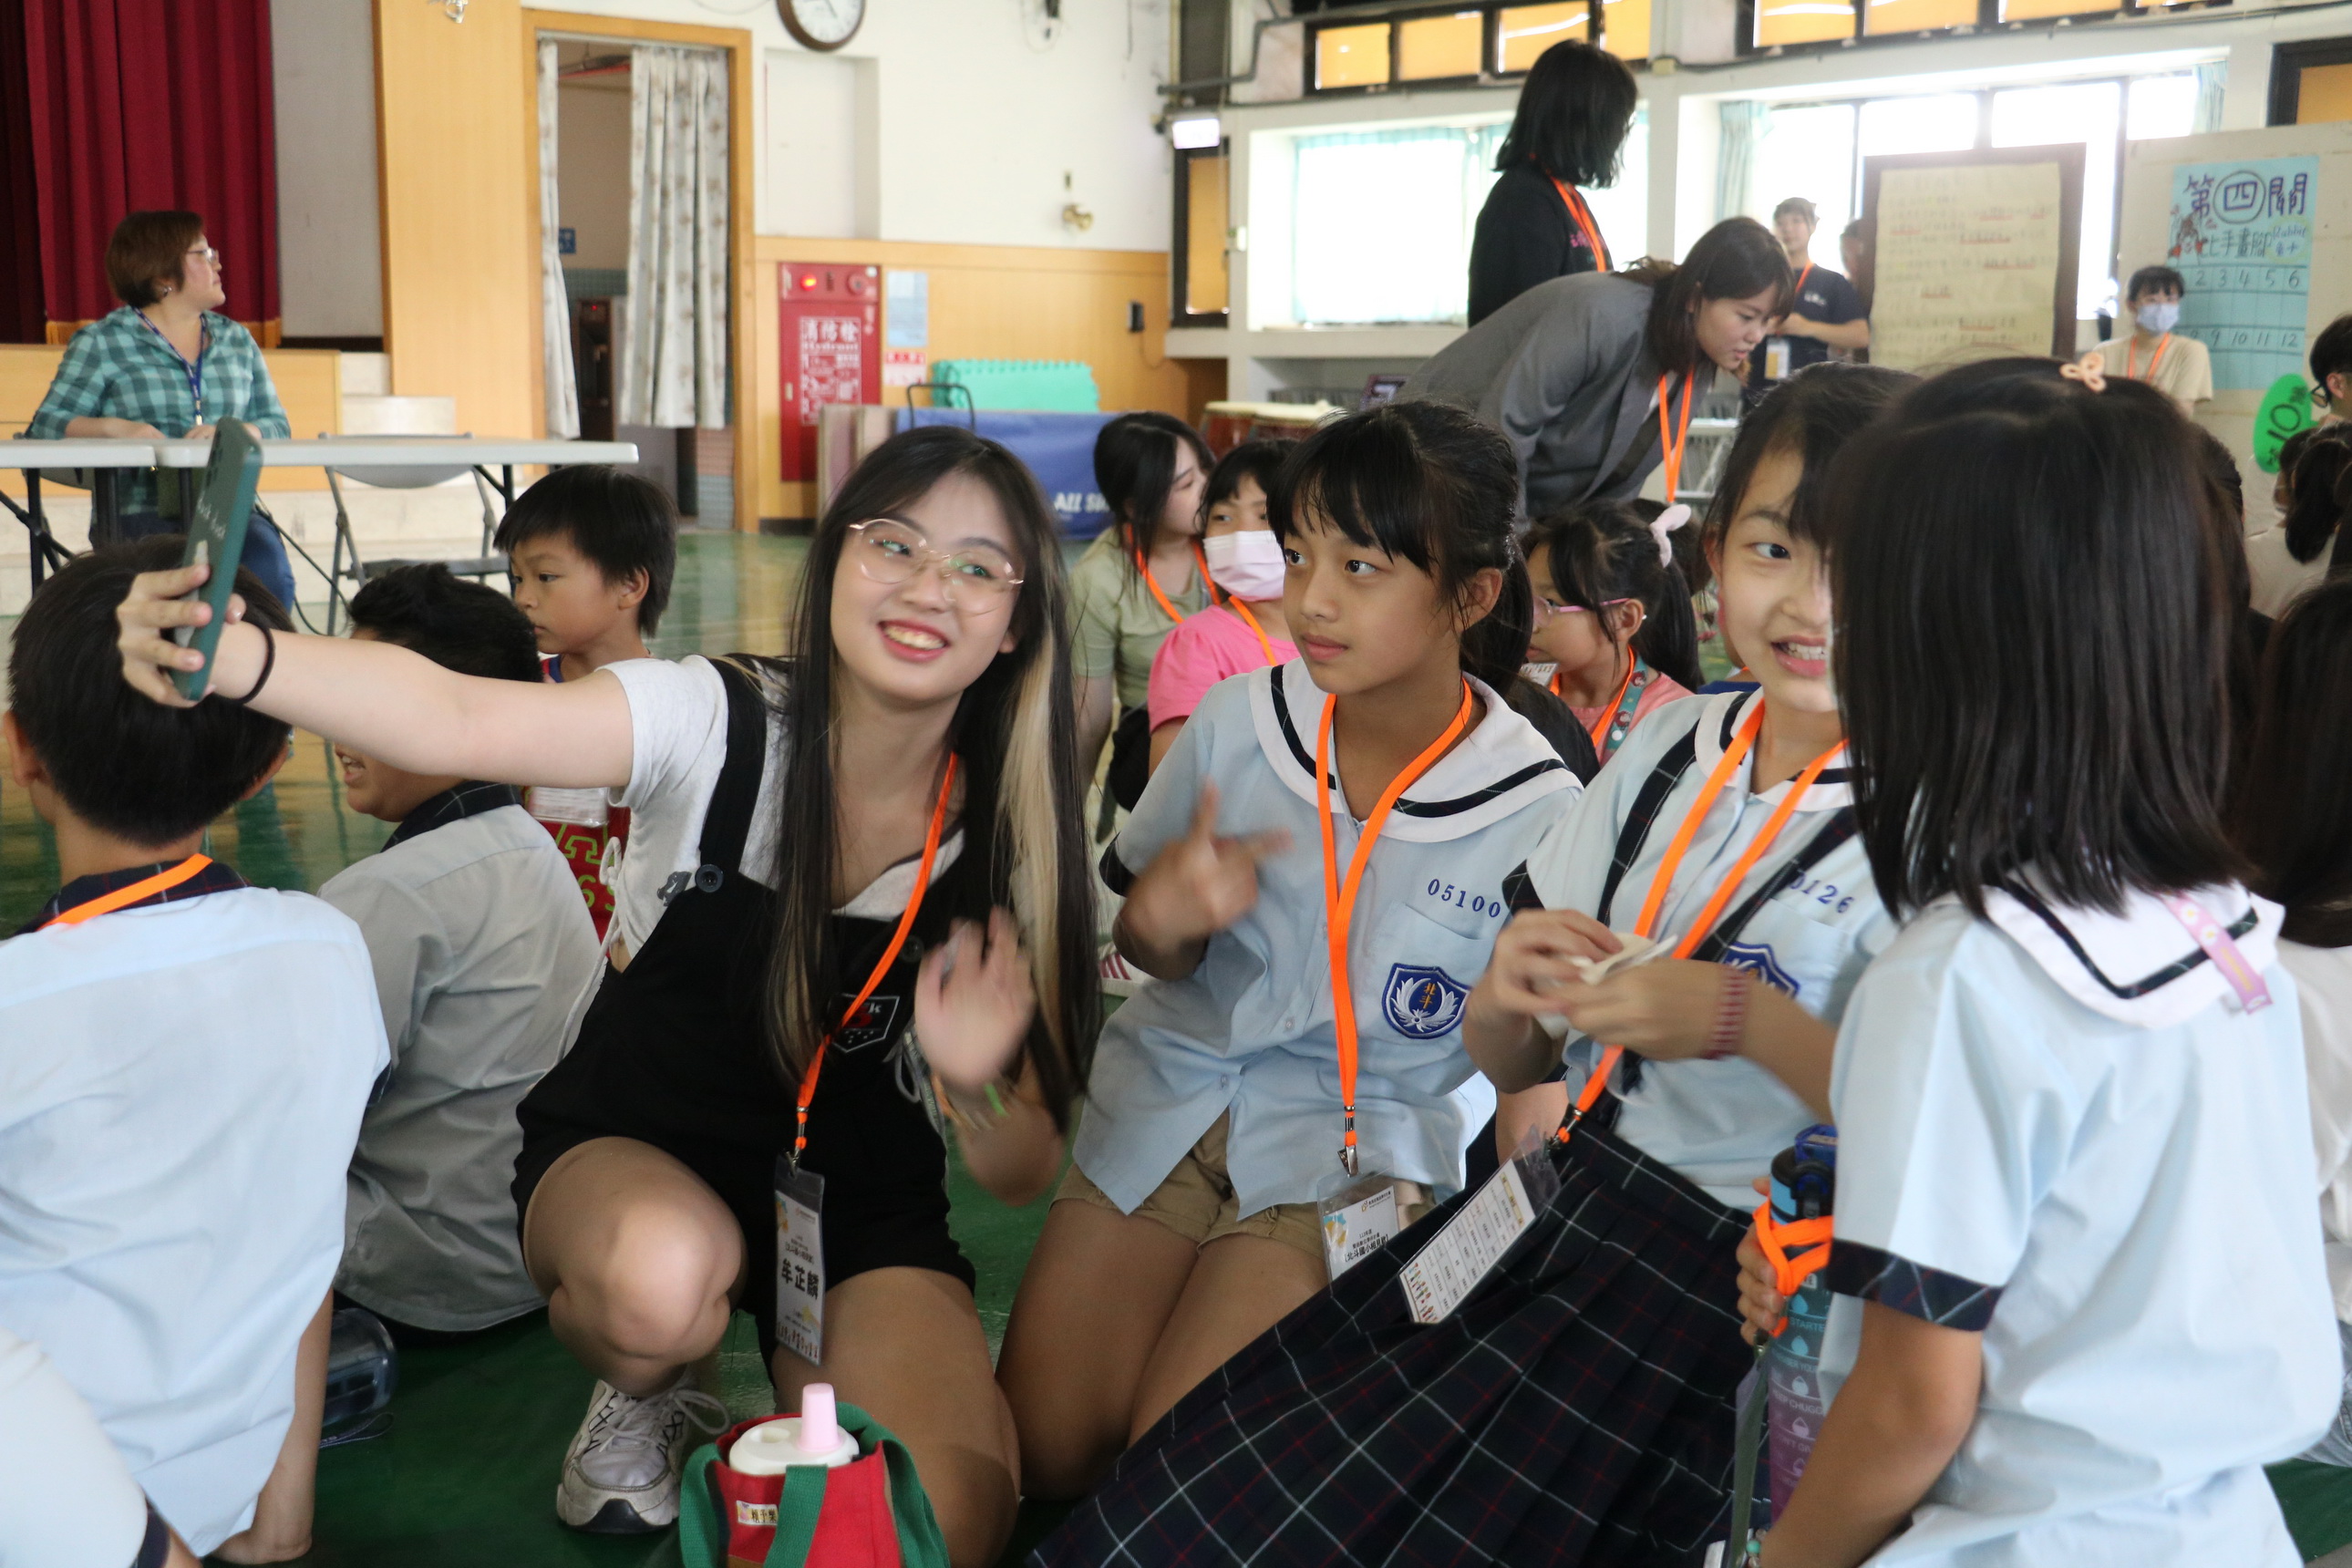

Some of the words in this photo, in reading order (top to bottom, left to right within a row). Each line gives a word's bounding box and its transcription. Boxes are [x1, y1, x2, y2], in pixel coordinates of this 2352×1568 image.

[2194, 269, 2206, 286] 2
[2218, 267, 2228, 287] 3
[2238, 268, 2250, 289] 4
[2265, 268, 2276, 288] 5
[2288, 269, 2300, 289] 6
[2232, 330, 2248, 346] 10
[2281, 333, 2299, 348] 12
[1427, 878, 1501, 918] 05100
